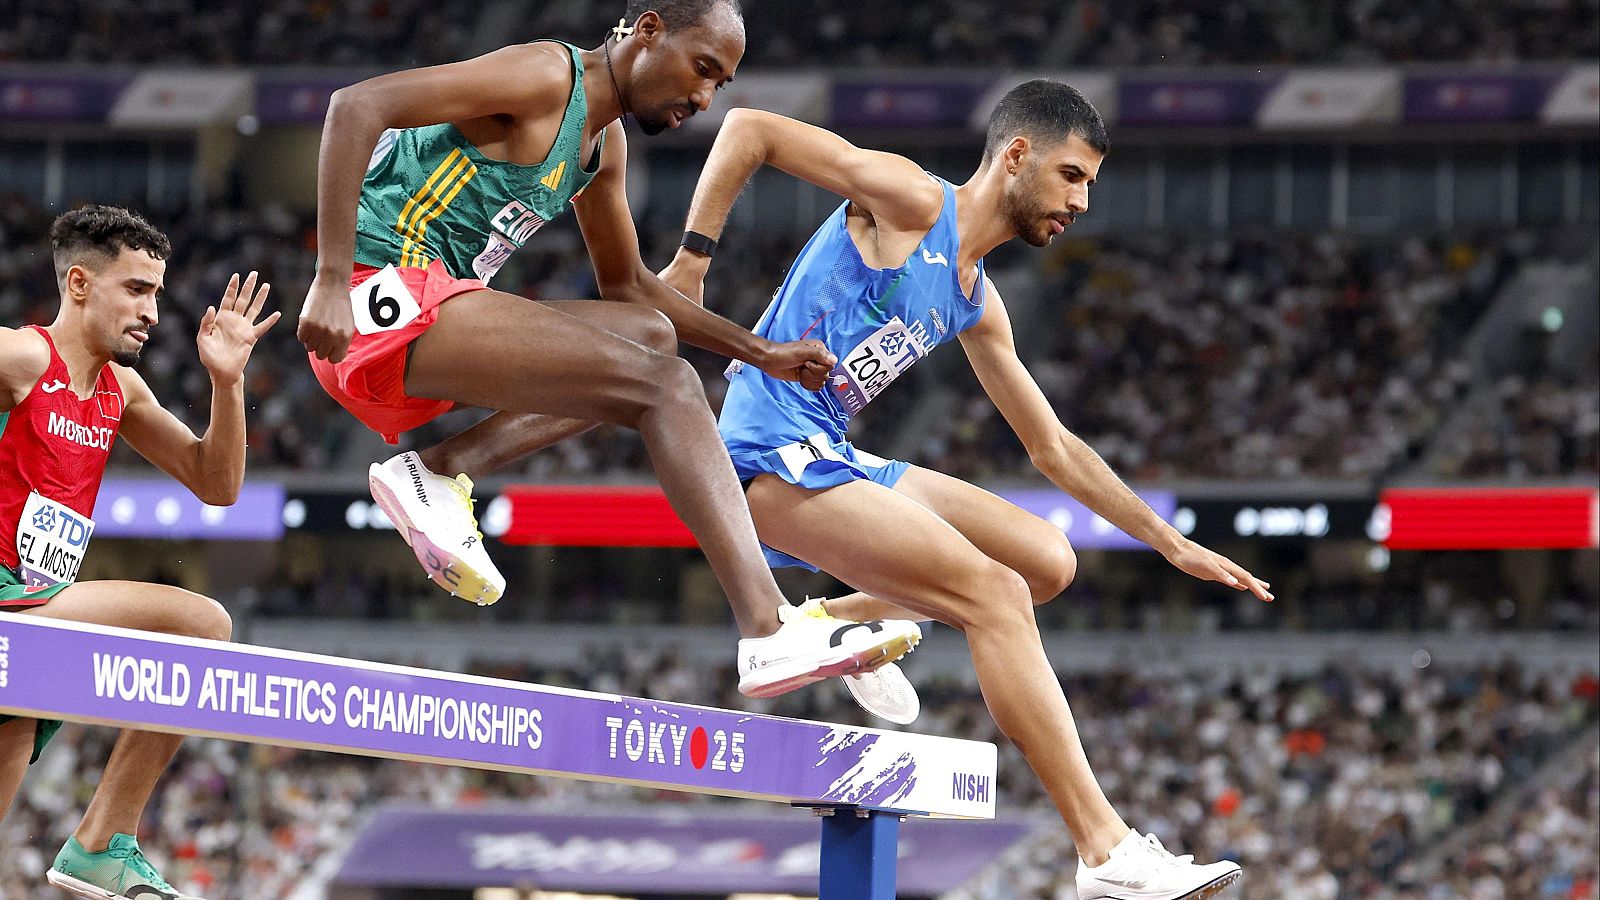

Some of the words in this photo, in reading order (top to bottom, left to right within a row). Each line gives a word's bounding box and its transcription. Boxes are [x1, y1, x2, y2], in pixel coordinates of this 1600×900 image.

[368, 283, 400, 327] 6
[407, 463, 431, 507] RUNNIN
[20, 532, 36, 564] EL
[92, 652, 191, 707] WORLD
[197, 667, 337, 725] ATHLETICS
[343, 685, 543, 750] CHAMPIONSHIPS
[952, 771, 990, 803] NISHI
